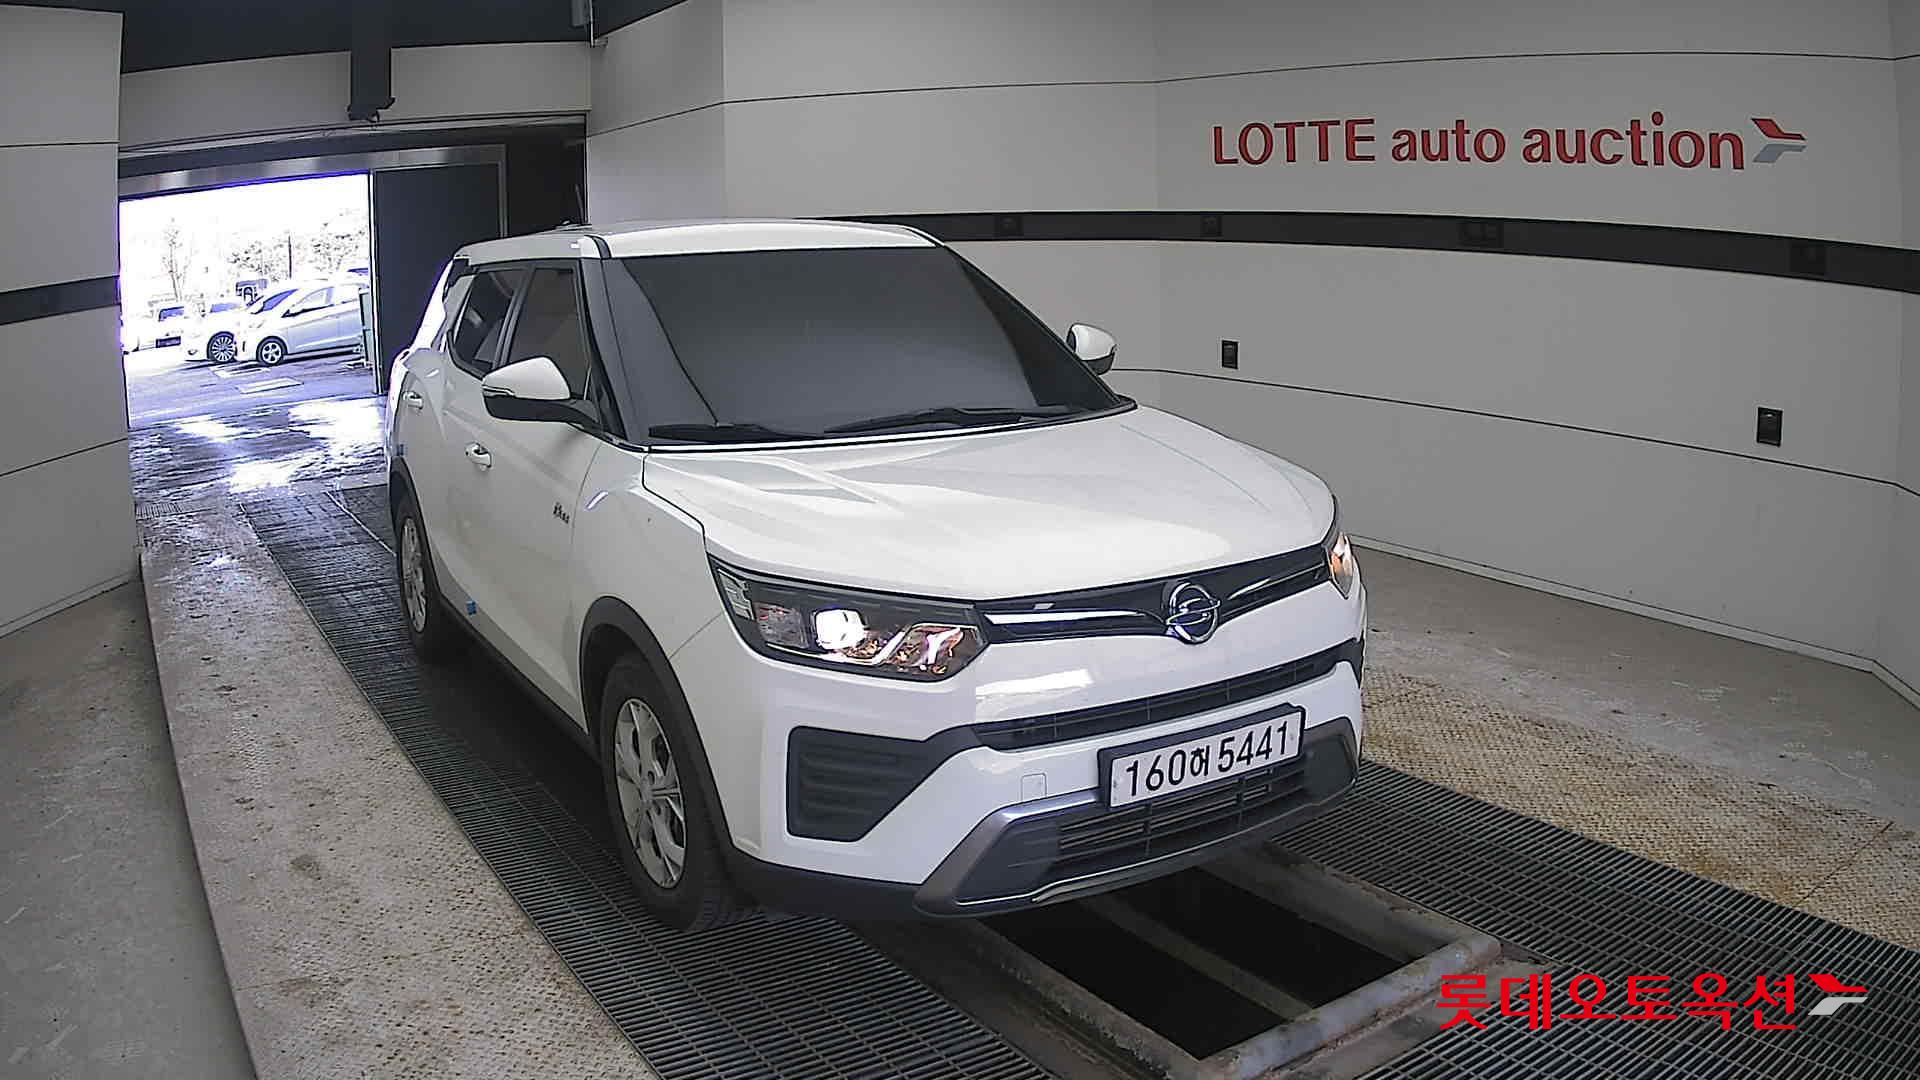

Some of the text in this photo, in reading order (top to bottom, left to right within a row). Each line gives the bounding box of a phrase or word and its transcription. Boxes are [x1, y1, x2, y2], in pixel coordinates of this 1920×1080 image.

[1213, 111, 1745, 170] LOTTE auto auction
[1126, 720, 1288, 796] 160허 5441
